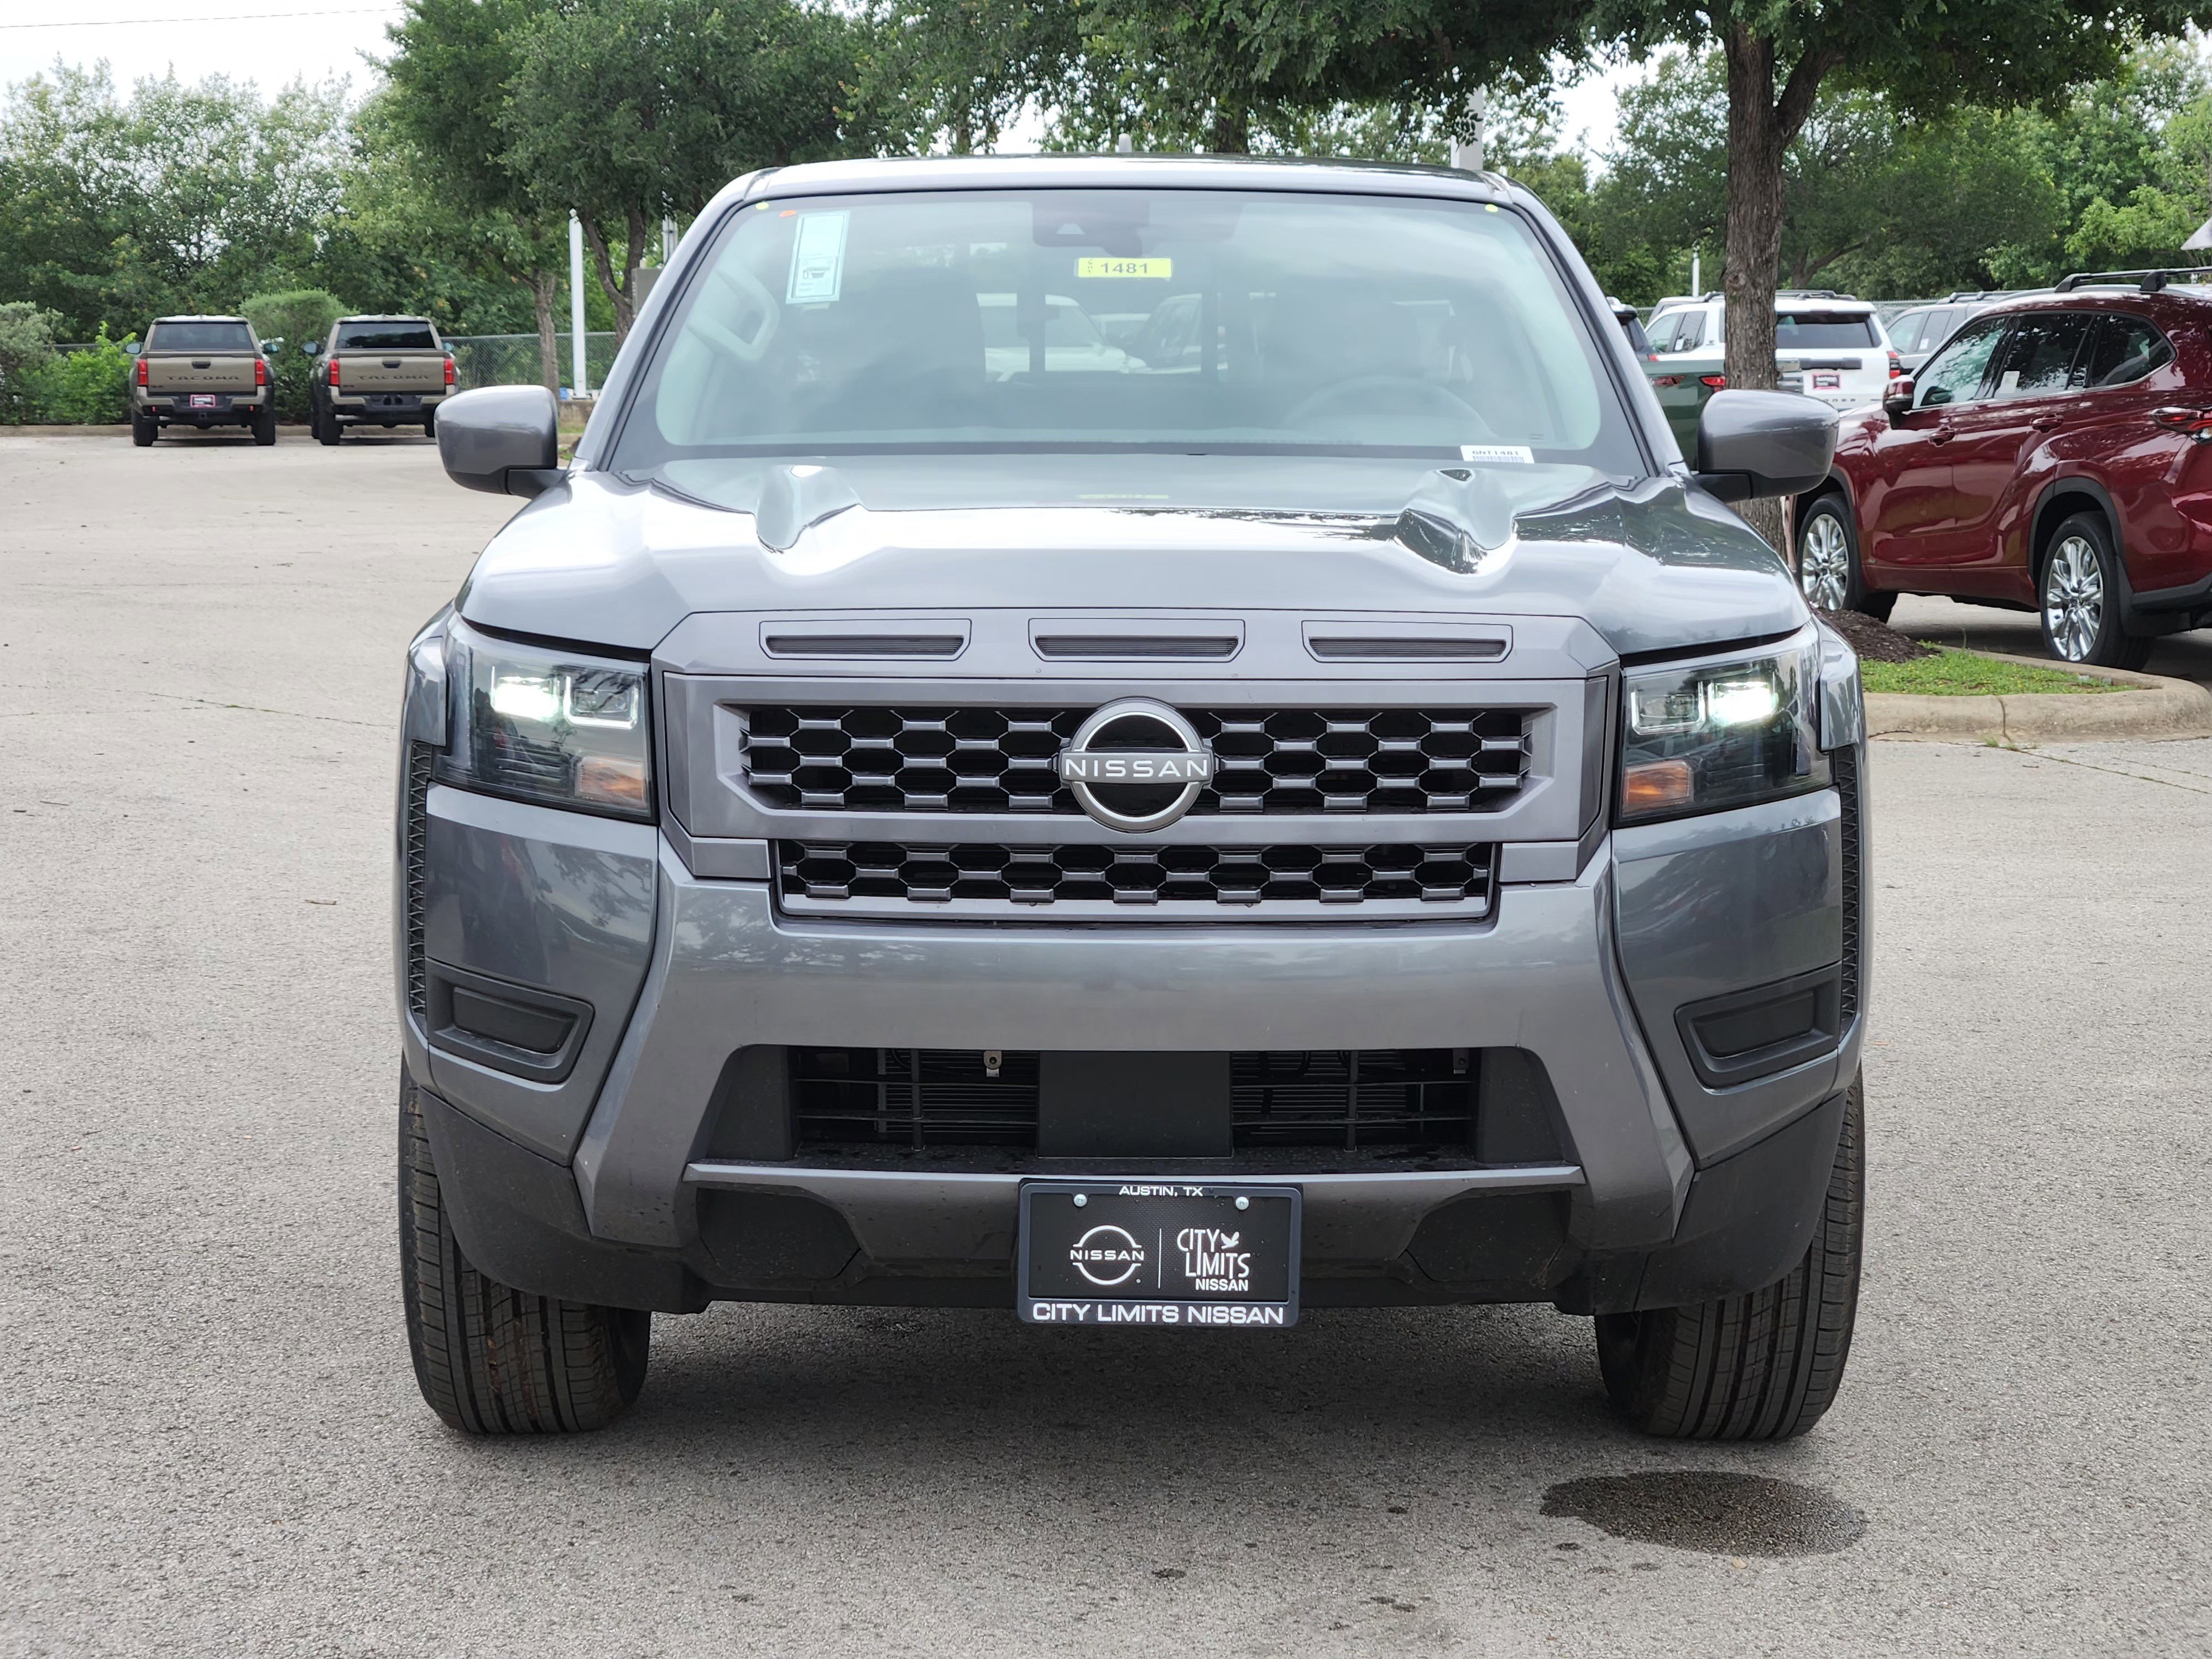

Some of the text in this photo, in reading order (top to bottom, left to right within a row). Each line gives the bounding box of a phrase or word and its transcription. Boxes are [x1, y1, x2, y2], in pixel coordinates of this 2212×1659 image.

[1100, 263, 1148, 274] 1481
[1066, 759, 1208, 778] NISSAN
[1119, 1186, 1203, 1197] AUSTIN, TX
[1177, 1228, 1220, 1253] CITY
[1070, 1249, 1144, 1262] NISSAN
[1185, 1252, 1251, 1278] LIMITS
[1195, 1279, 1249, 1292] NISSAN
[1032, 1302, 1284, 1325] CITY LIMITS NISSAN
